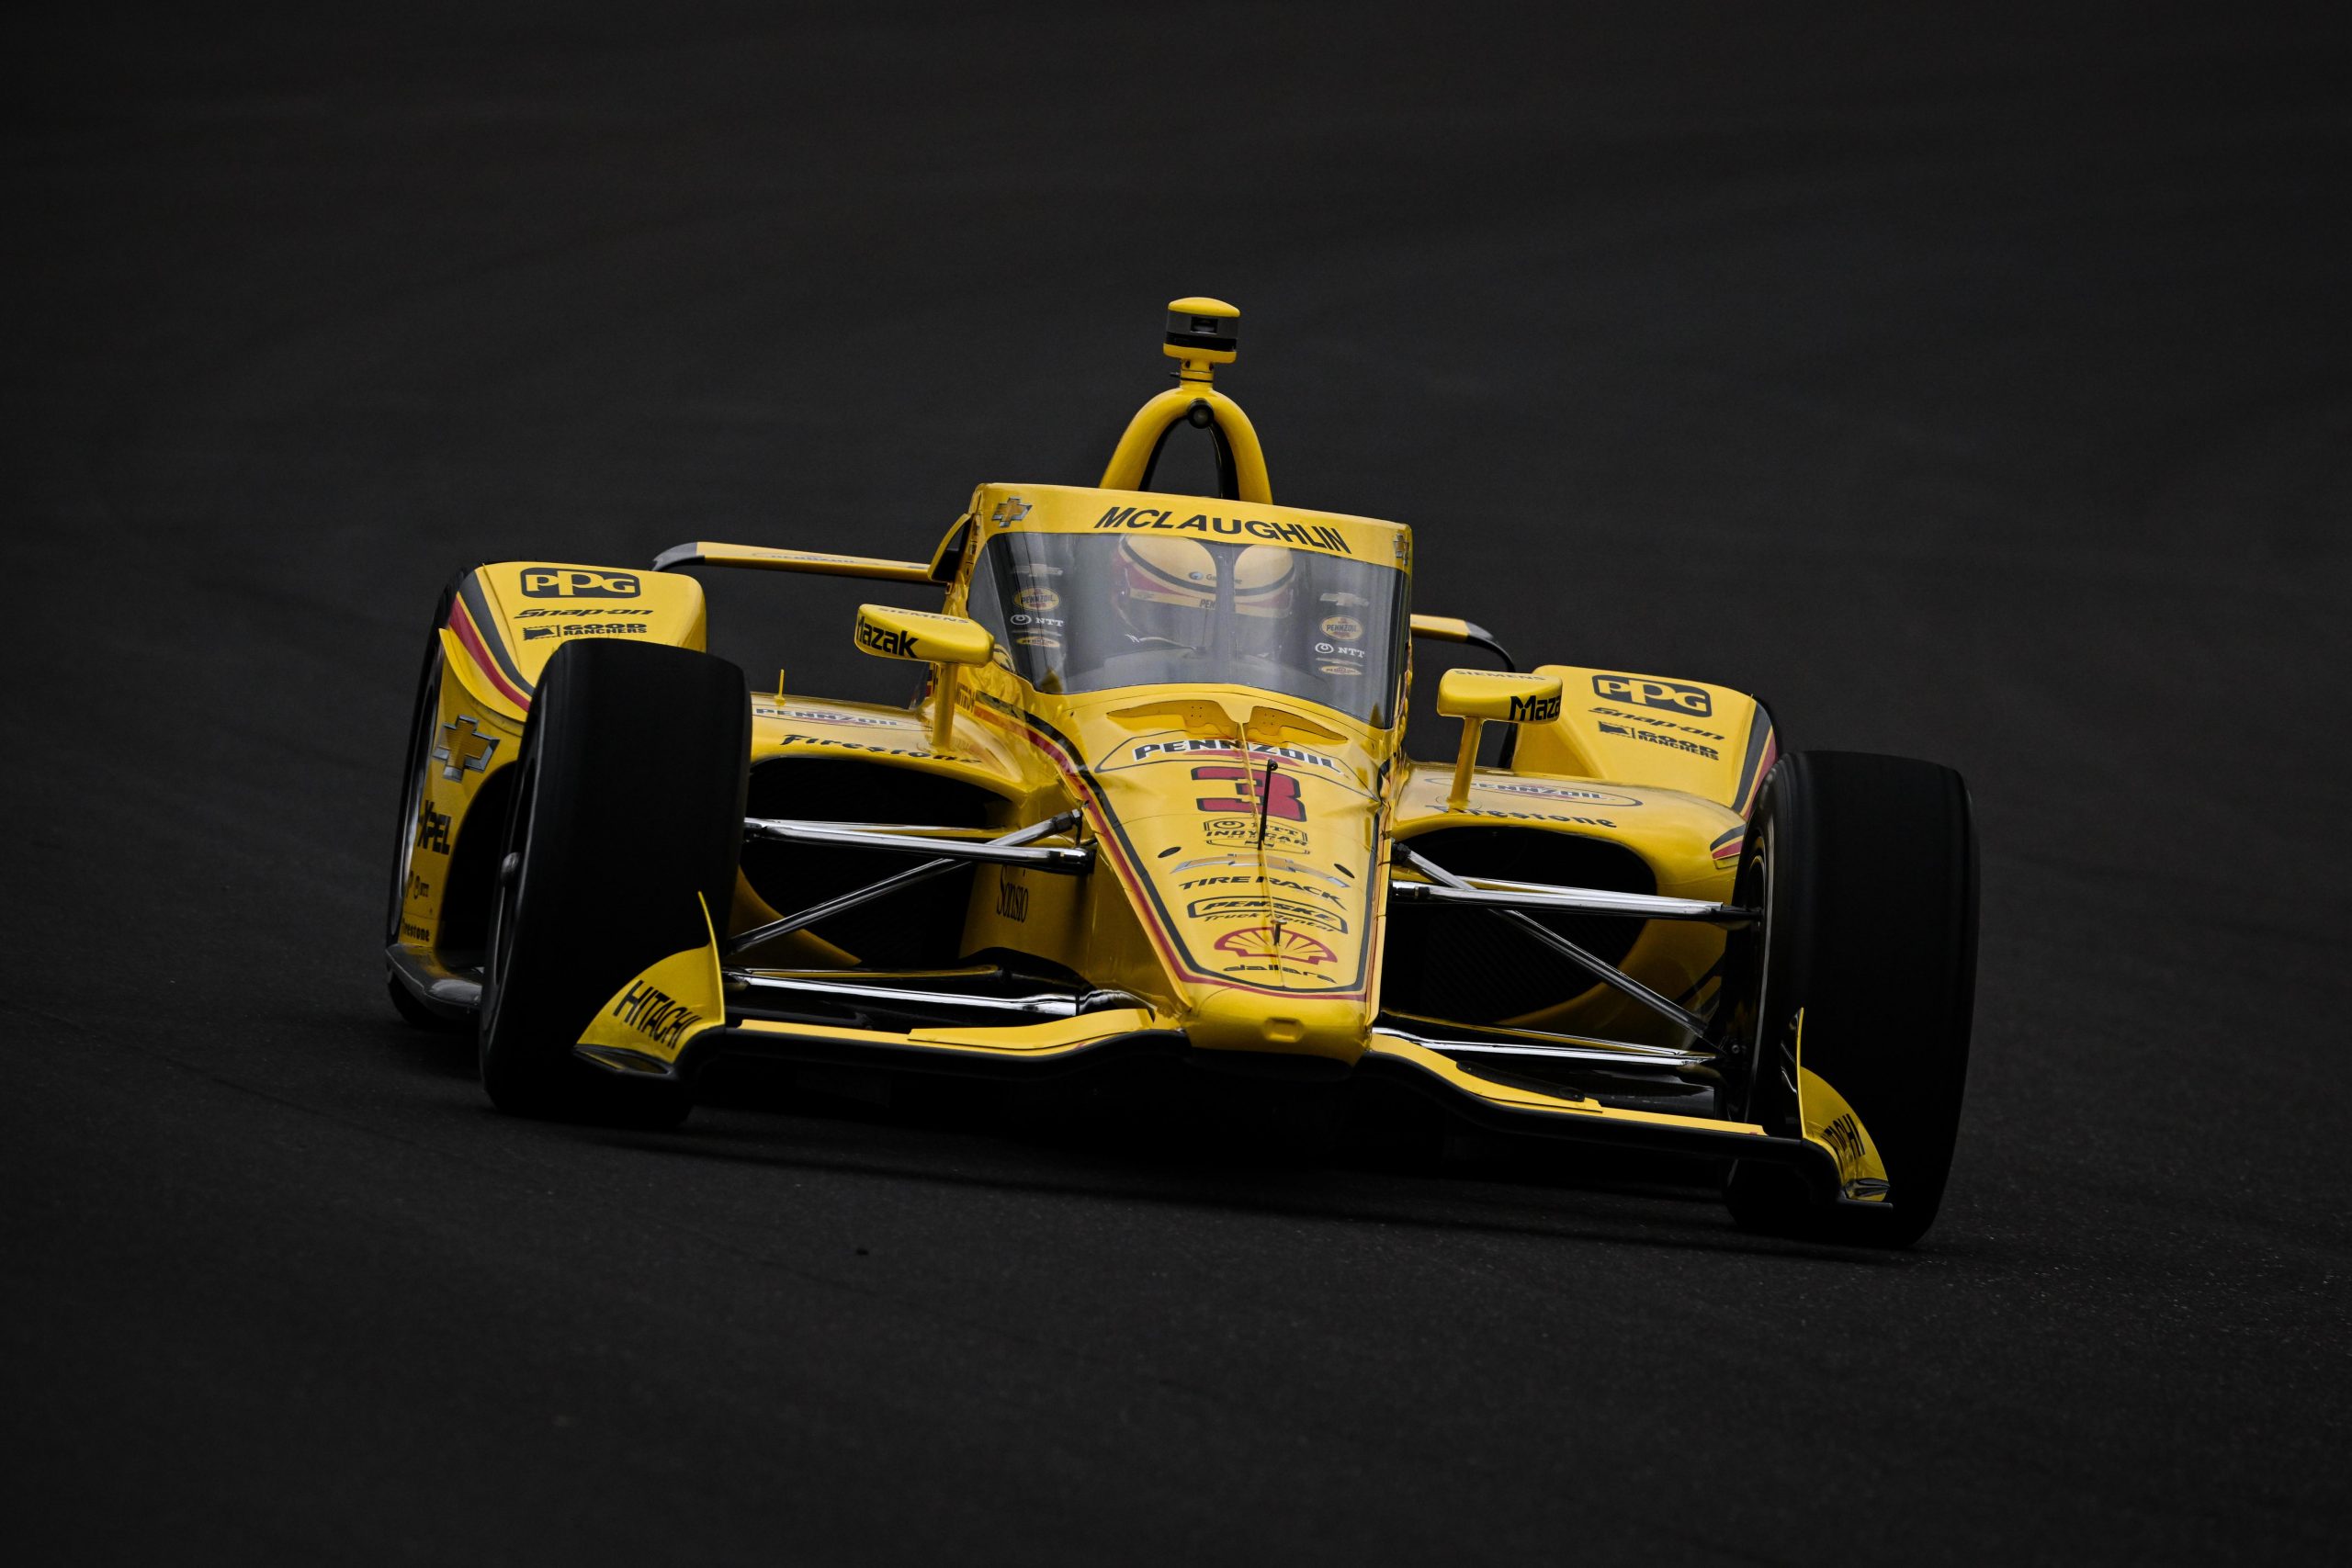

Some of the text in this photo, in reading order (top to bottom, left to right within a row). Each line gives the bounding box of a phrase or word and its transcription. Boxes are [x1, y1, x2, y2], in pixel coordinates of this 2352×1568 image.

[1094, 507, 1351, 554] MCLAUGHLIN
[524, 570, 637, 596] PPG
[514, 608, 653, 619] Snap-on
[1035, 617, 1064, 627] NTT
[562, 623, 648, 631] GOOD
[1338, 647, 1365, 659] NTT
[1508, 694, 1562, 722] Maza
[1597, 679, 1708, 713] PPG
[1588, 706, 1726, 741] Snap-on
[780, 734, 982, 764] Firestone
[1637, 730, 1720, 755] GOOD
[1638, 735, 1720, 761] RANCHERS
[1132, 738, 1344, 775] PENNZOIL
[1191, 766, 1307, 822] 3
[1470, 784, 1602, 800] ENNZOIL
[1206, 829, 1308, 846] INDYCAR
[1179, 875, 1348, 912] TIRE RACK
[1202, 900, 1337, 922] PENSKE
[1204, 912, 1260, 923] Truck
[1223, 964, 1338, 985] dallara
[612, 979, 703, 1050] HITACHI
